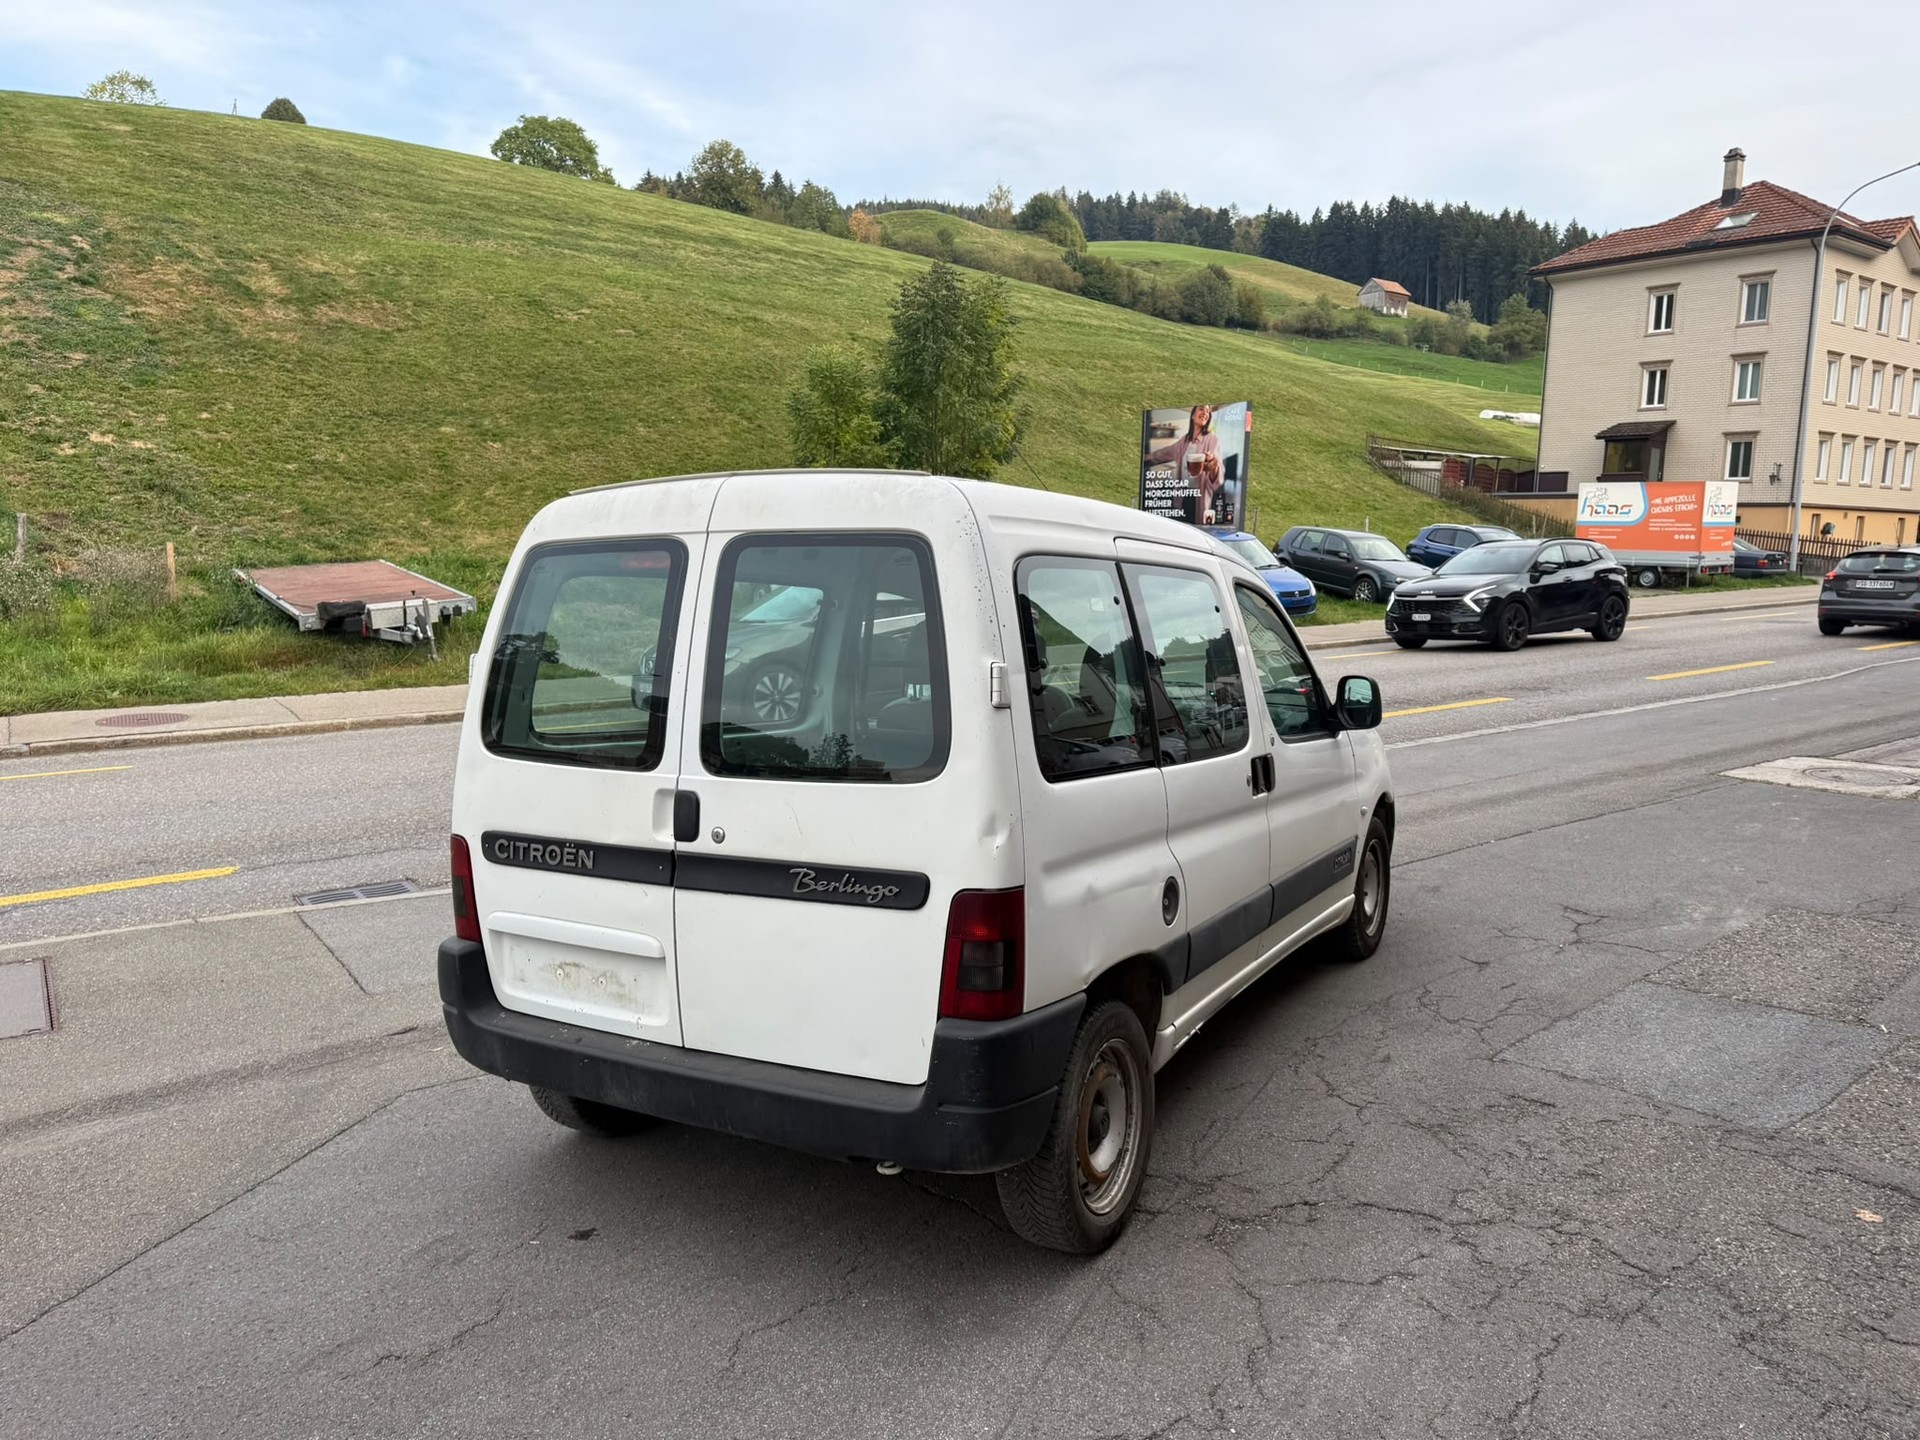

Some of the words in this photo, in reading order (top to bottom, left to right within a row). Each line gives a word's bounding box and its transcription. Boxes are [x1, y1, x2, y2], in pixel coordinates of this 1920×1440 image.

[1145, 471, 1156, 479] SO
[1145, 480, 1163, 488] DASS
[1164, 479, 1189, 488] SOGAR
[1145, 488, 1202, 498] MORGENMUFFEL
[1144, 497, 1172, 508] FRÜHER
[1581, 496, 1633, 517] haas
[495, 839, 594, 870] CITROËN
[789, 868, 899, 903] Berlingo
